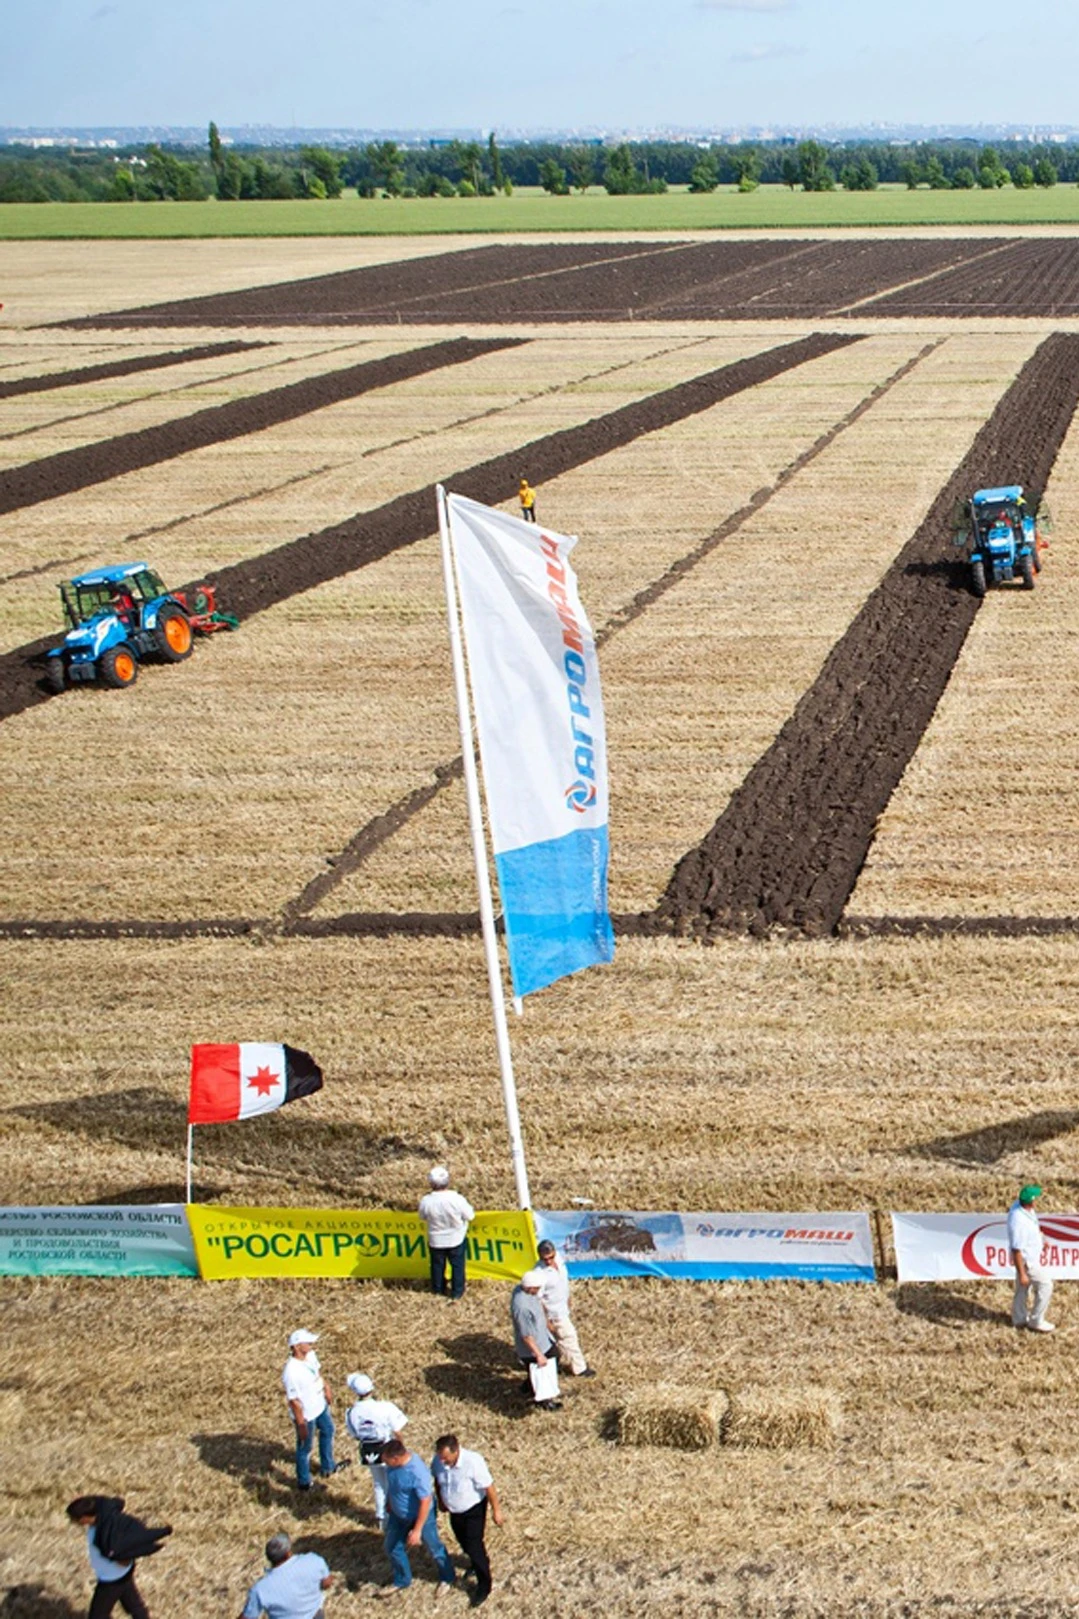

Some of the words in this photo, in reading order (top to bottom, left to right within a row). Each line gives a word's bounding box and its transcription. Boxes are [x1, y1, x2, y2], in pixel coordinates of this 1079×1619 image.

[41, 1211, 124, 1221] РОСТОВСКОЙ
[128, 1212, 182, 1225] ОБЛАСТИ
[204, 1219, 294, 1233] ОТКРЫТОЕ
[8, 1249, 76, 1260] РОСТОВСКОЙ
[79, 1251, 127, 1261] ОБЛАСТИ
